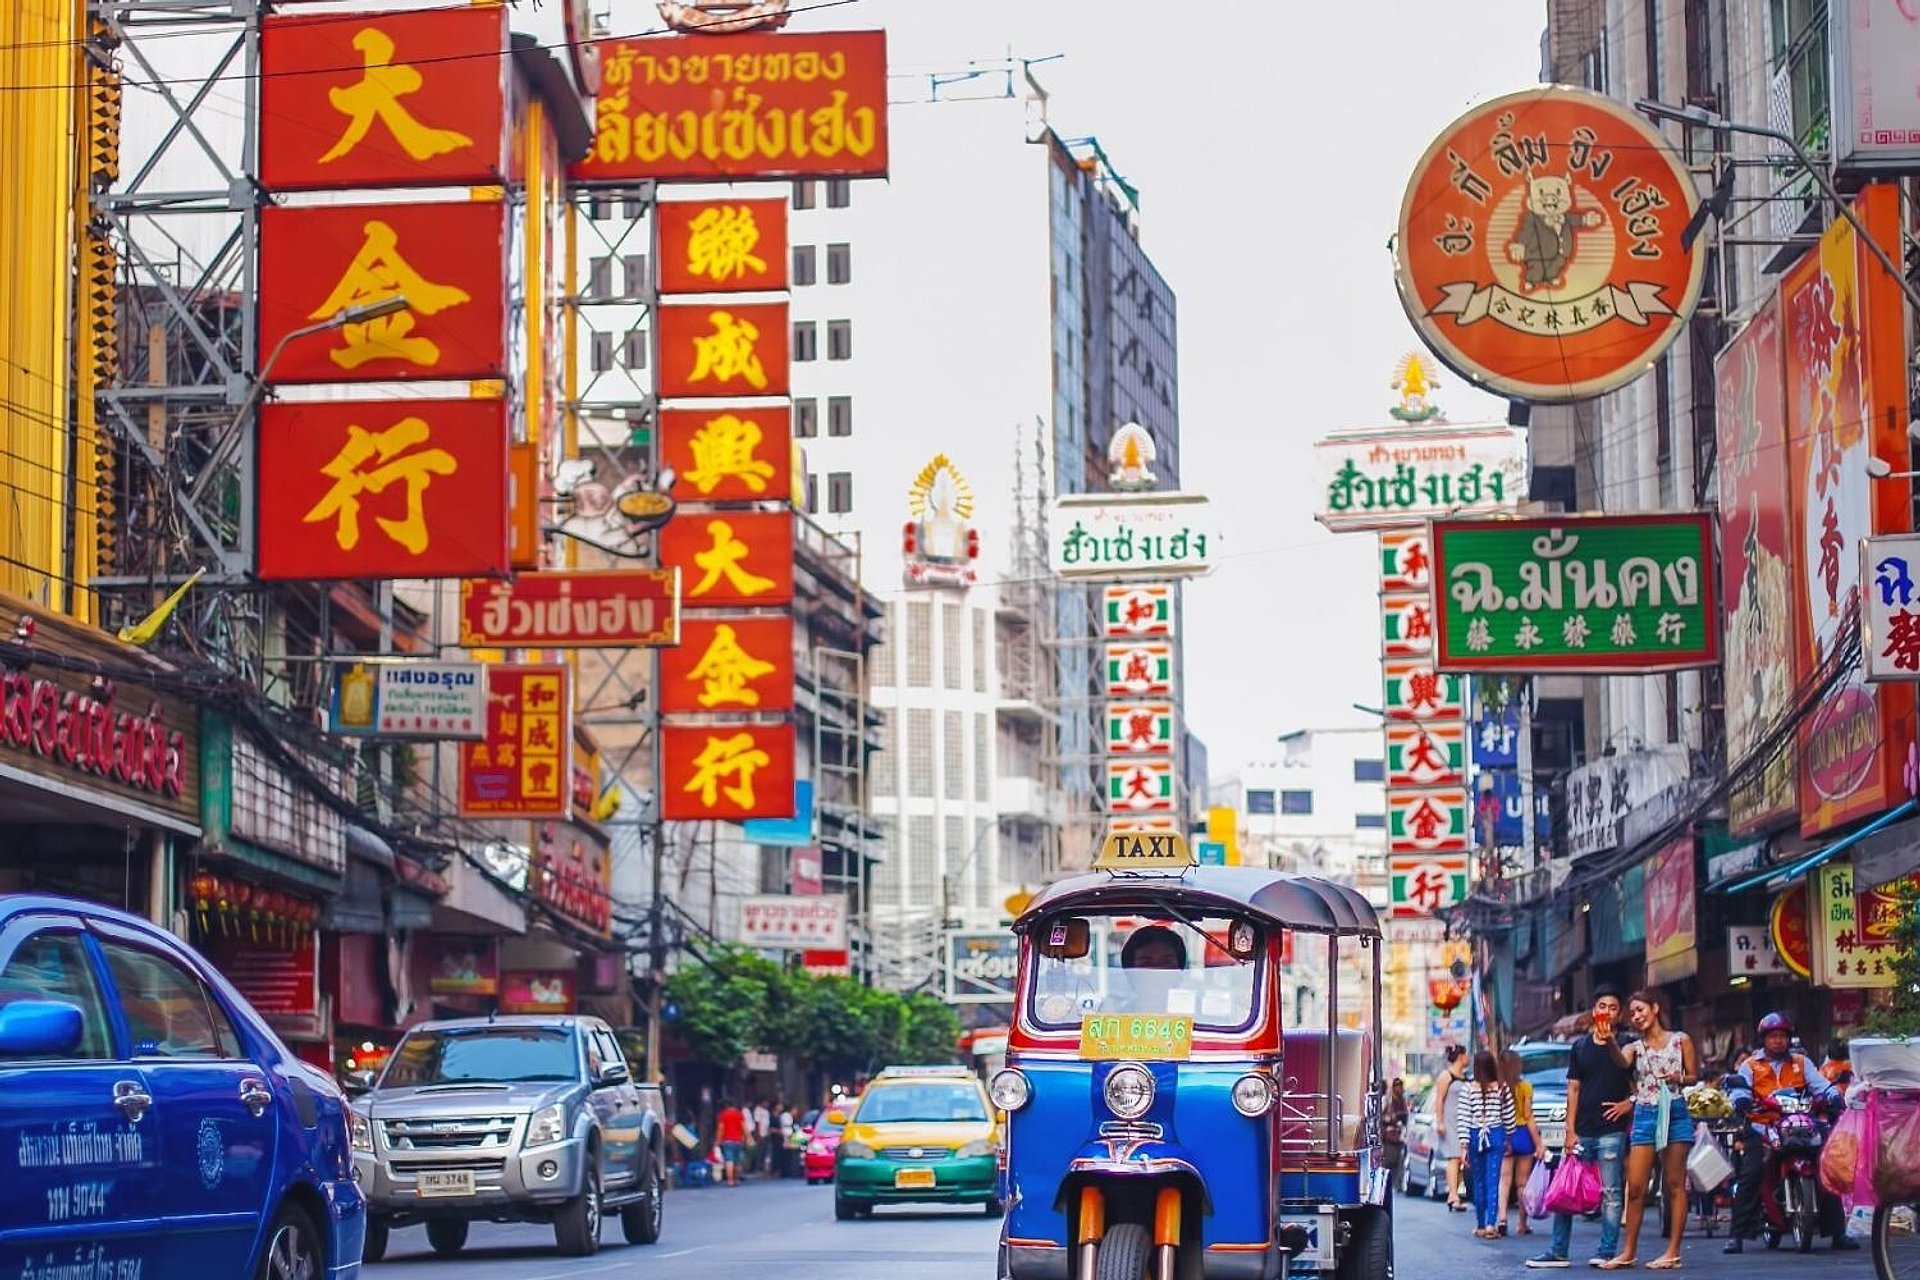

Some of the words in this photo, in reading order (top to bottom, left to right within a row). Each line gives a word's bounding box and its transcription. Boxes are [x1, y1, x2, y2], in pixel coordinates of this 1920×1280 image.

[604, 44, 846, 84] ห้างขายทอง
[304, 27, 474, 556] 大金行
[1450, 527, 1699, 613] ฉ.มั่นคง
[1113, 836, 1176, 857] TAXI
[1130, 1017, 1187, 1041] 6646
[72, 1182, 105, 1216] 9044
